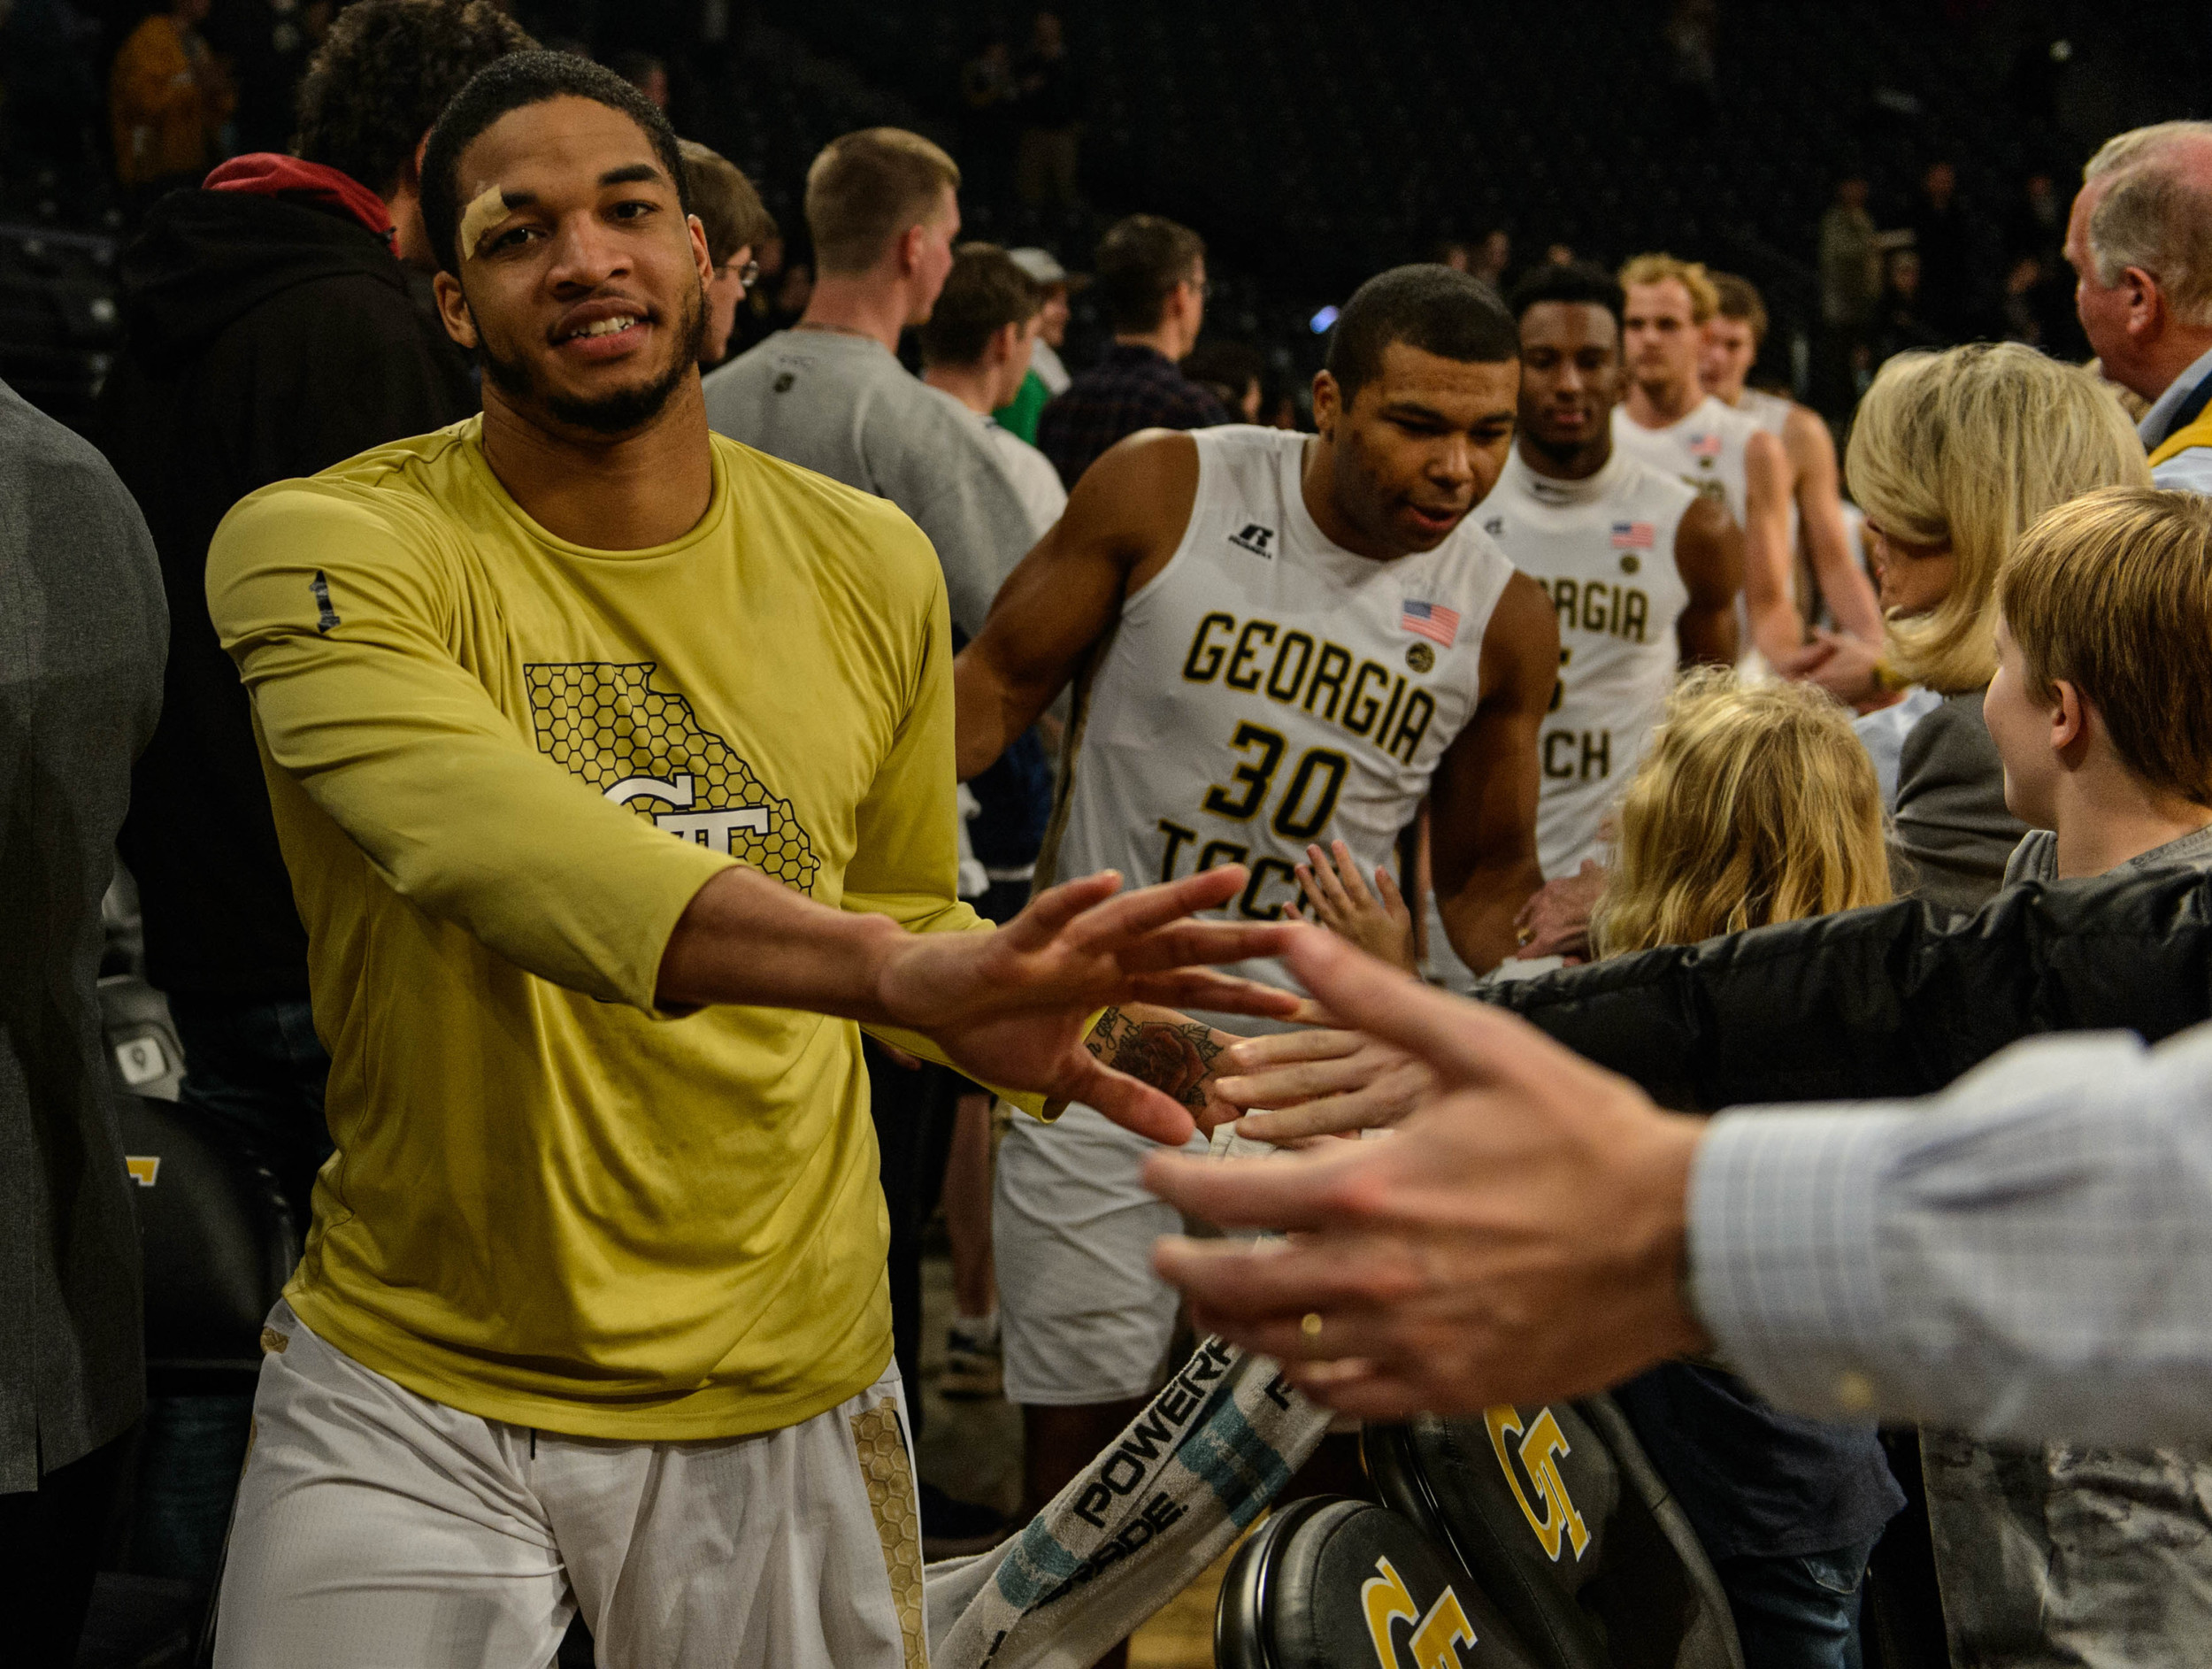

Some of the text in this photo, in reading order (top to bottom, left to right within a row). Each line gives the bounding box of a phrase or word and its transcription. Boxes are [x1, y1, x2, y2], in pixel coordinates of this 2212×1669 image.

[1540, 579, 1647, 642] RGIA
[1181, 611, 1435, 766] GEORGIA
[1201, 719, 1349, 839] 30
